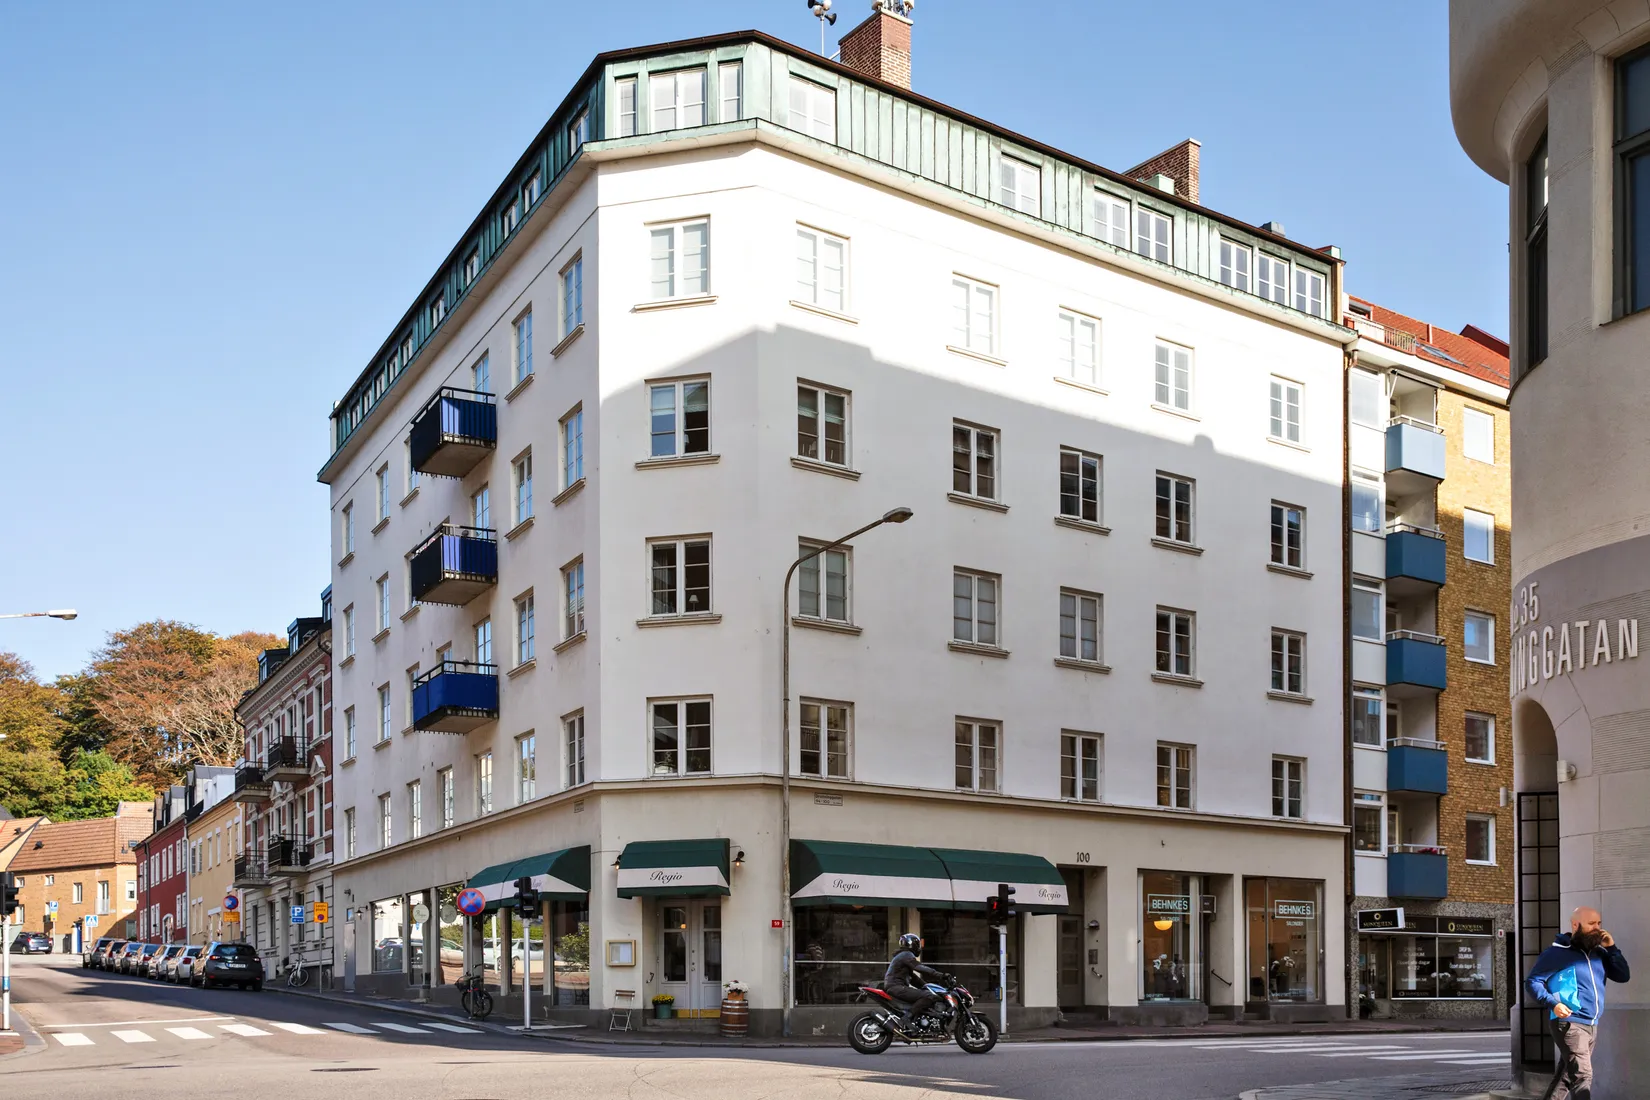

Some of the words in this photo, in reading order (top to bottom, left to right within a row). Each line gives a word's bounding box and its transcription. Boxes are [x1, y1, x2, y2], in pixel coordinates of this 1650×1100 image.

[1520, 581, 1539, 626] 35
[1076, 852, 1091, 863] 100
[650, 870, 683, 884] Regio
[833, 878, 860, 892] Regio
[1038, 888, 1061, 901] Regio
